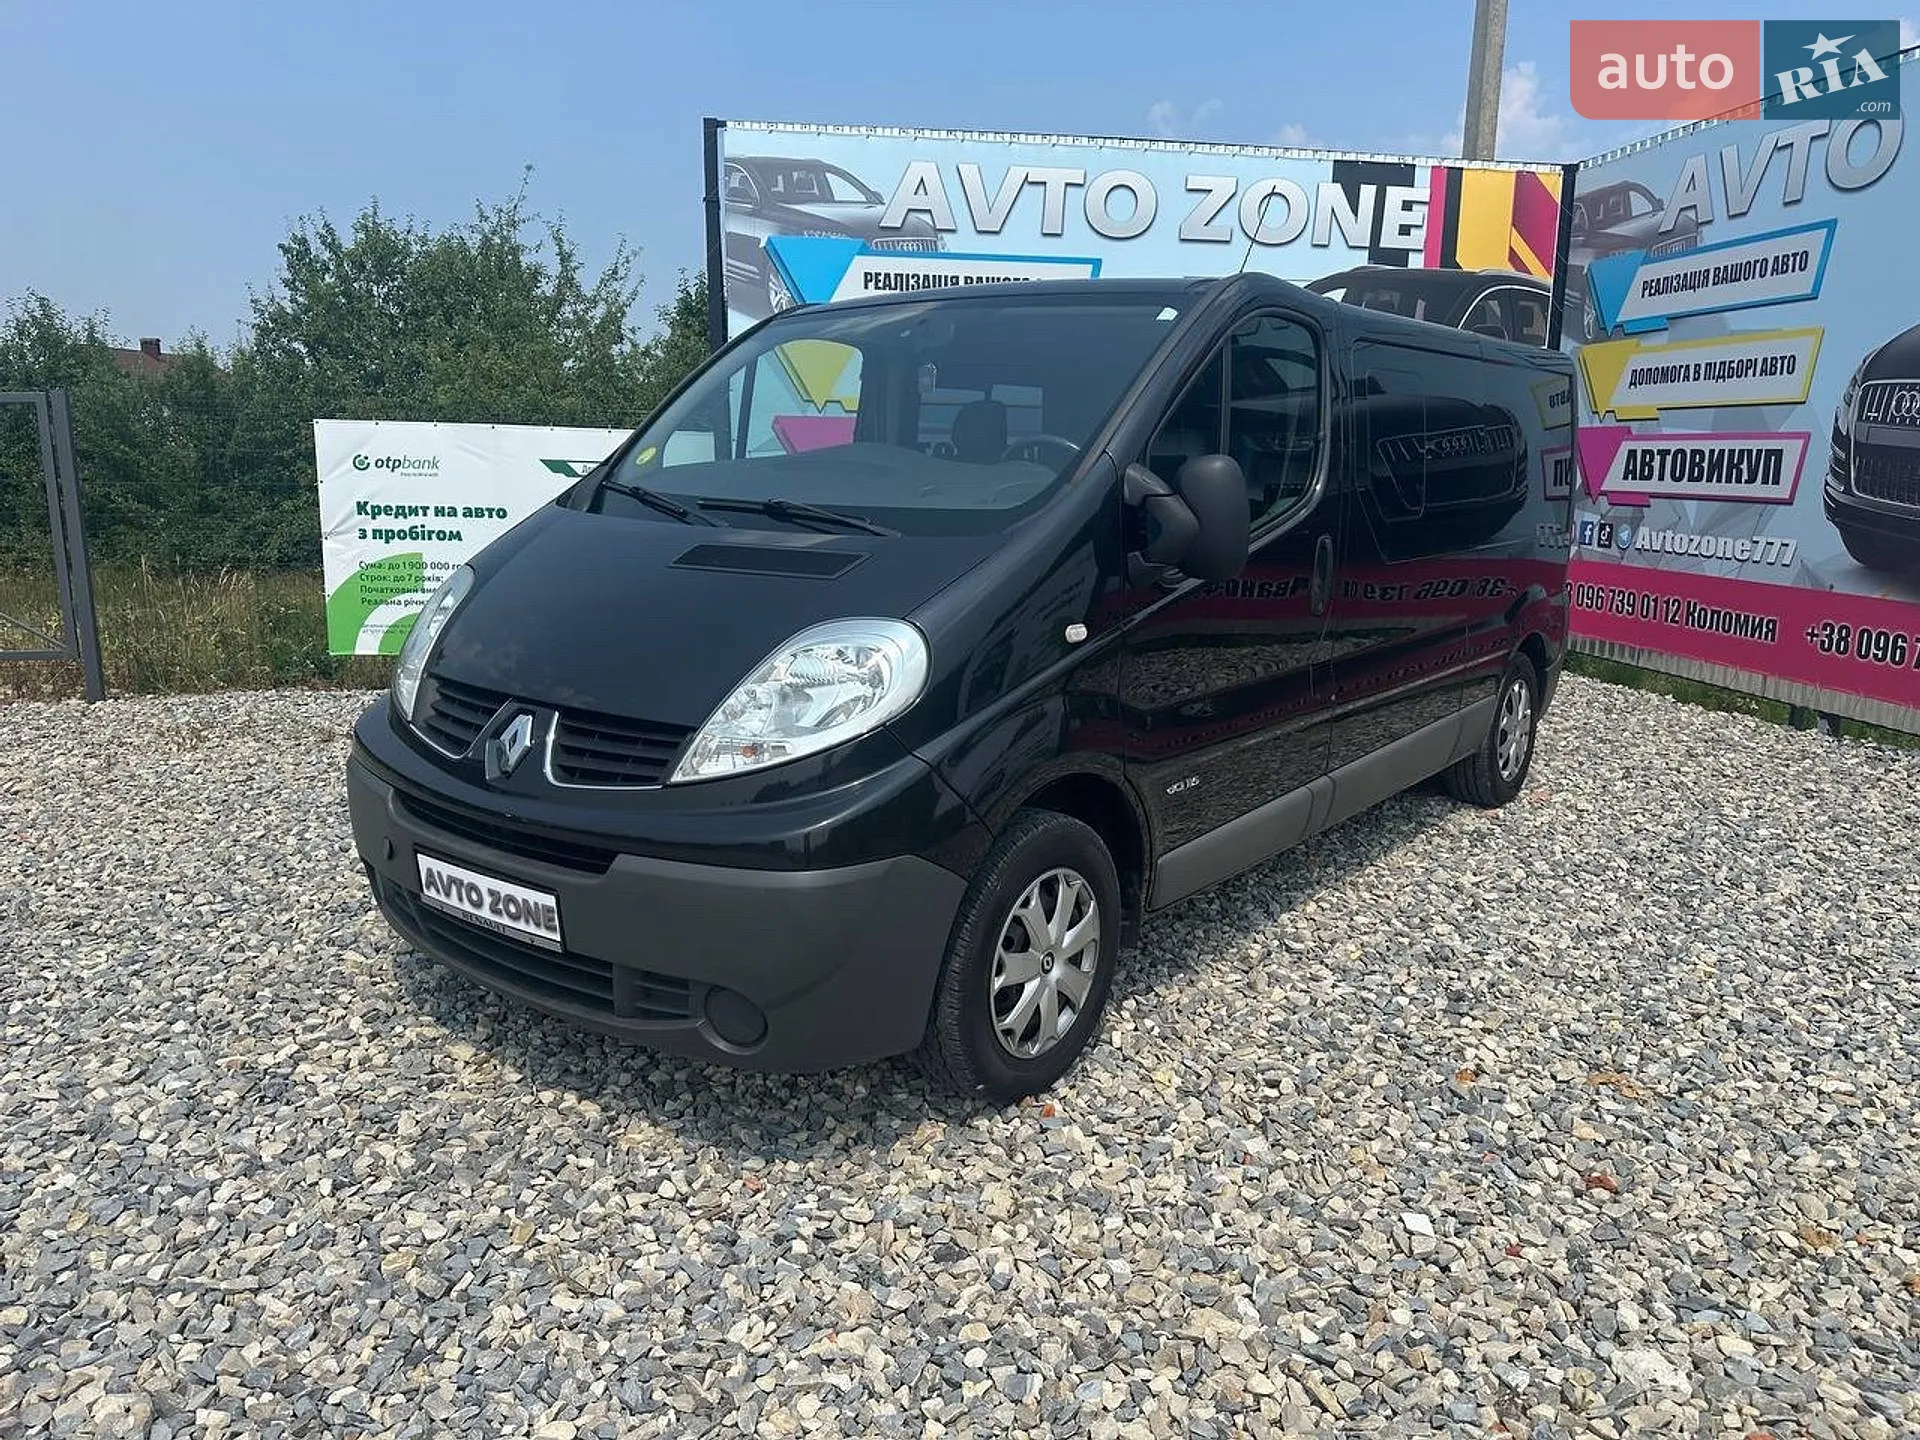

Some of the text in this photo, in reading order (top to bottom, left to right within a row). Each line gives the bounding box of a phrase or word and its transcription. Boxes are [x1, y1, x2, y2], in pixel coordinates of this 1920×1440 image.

[1658, 104, 1904, 235] AVTO
[879, 160, 1431, 252] AVTO ZONE
[1641, 250, 1810, 298] РЕАЛІЗАЦІЯ ВАШОГО АВТО
[1628, 354, 1797, 390] ДОПОМОГА В ПІДБОРІ АВТО
[374, 455, 440, 473] otpbank
[1622, 447, 1784, 486] АВТОВИКУП
[355, 500, 508, 520] Кредит на авто
[358, 524, 463, 544] з пробігом
[1635, 525, 1798, 567] Avtozone777
[388, 561, 401, 571] до
[393, 574, 406, 583] до
[1576, 582, 1605, 612] 096
[1608, 587, 1637, 617] 739
[1641, 592, 1659, 621] 01
[1663, 596, 1681, 625] 12
[1684, 599, 1778, 643] Коломия
[1805, 621, 1852, 656] +38
[1856, 627, 1908, 667] 096
[423, 866, 557, 933] AVTO ZONE
